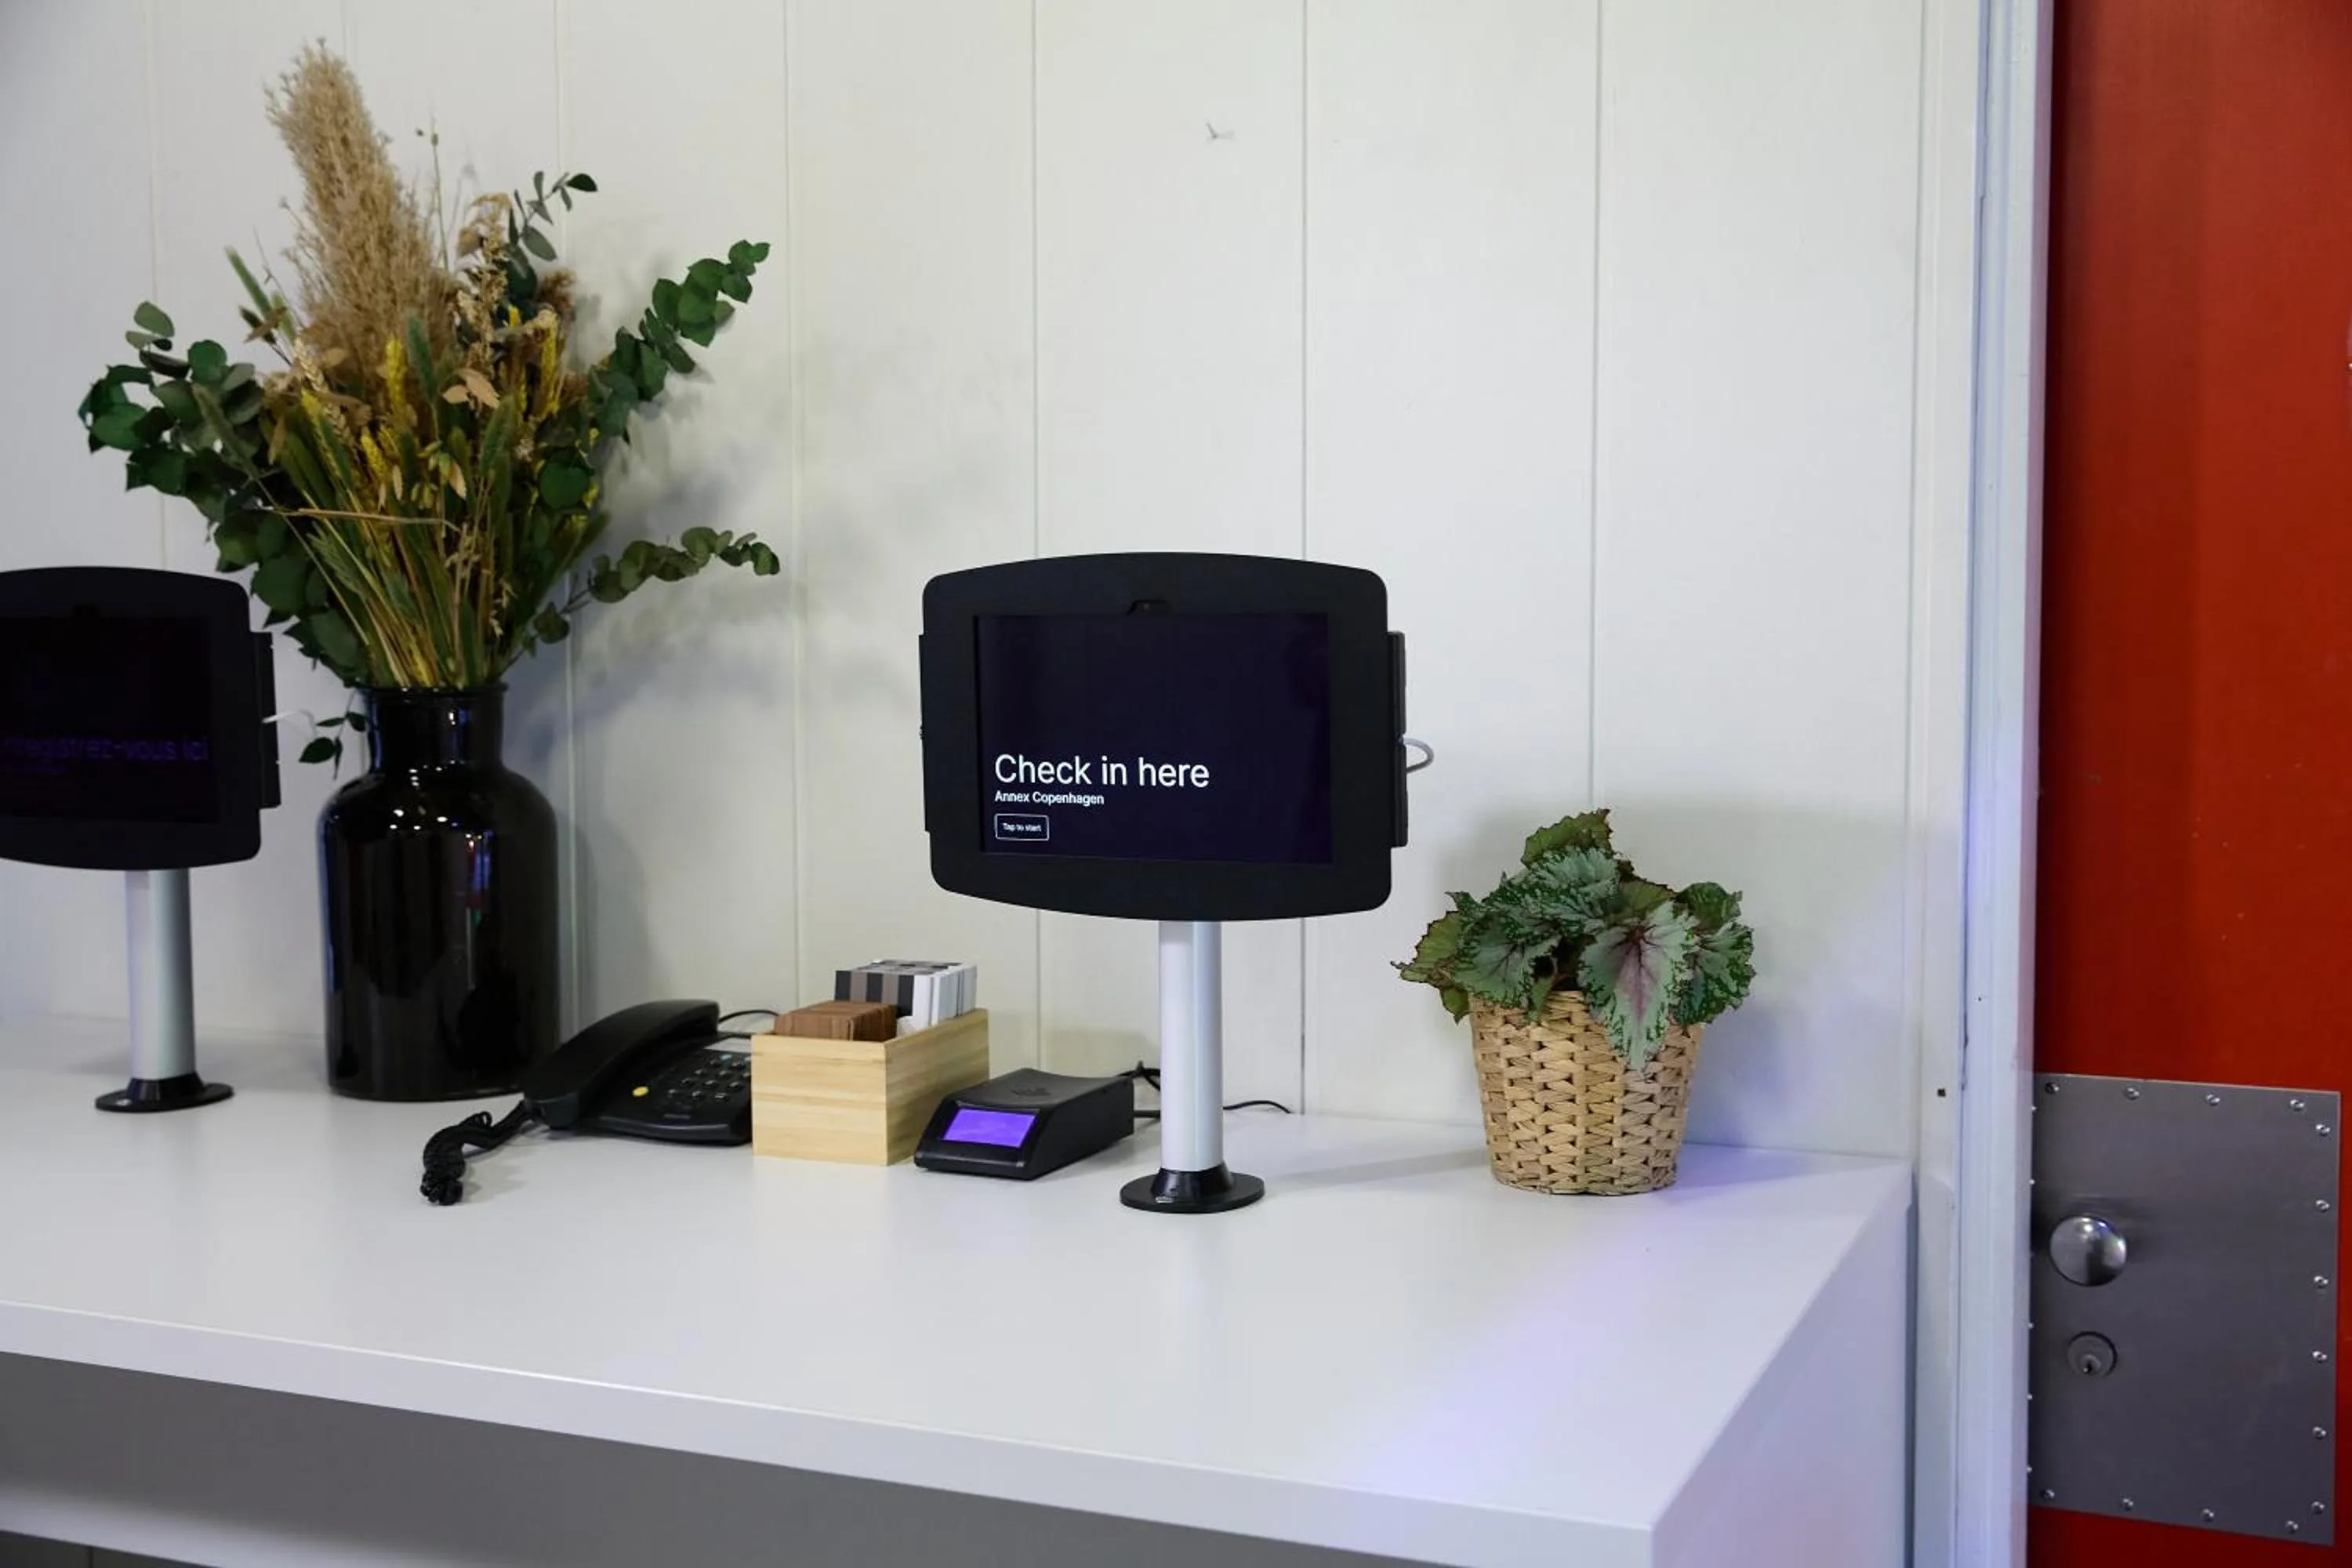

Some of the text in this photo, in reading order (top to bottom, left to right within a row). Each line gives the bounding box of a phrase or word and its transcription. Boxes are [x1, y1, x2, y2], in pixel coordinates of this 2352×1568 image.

[995, 753, 1210, 788] Check in here
[994, 790, 1105, 807] Annex Copenhagen
[1002, 822, 1015, 832] Tap
